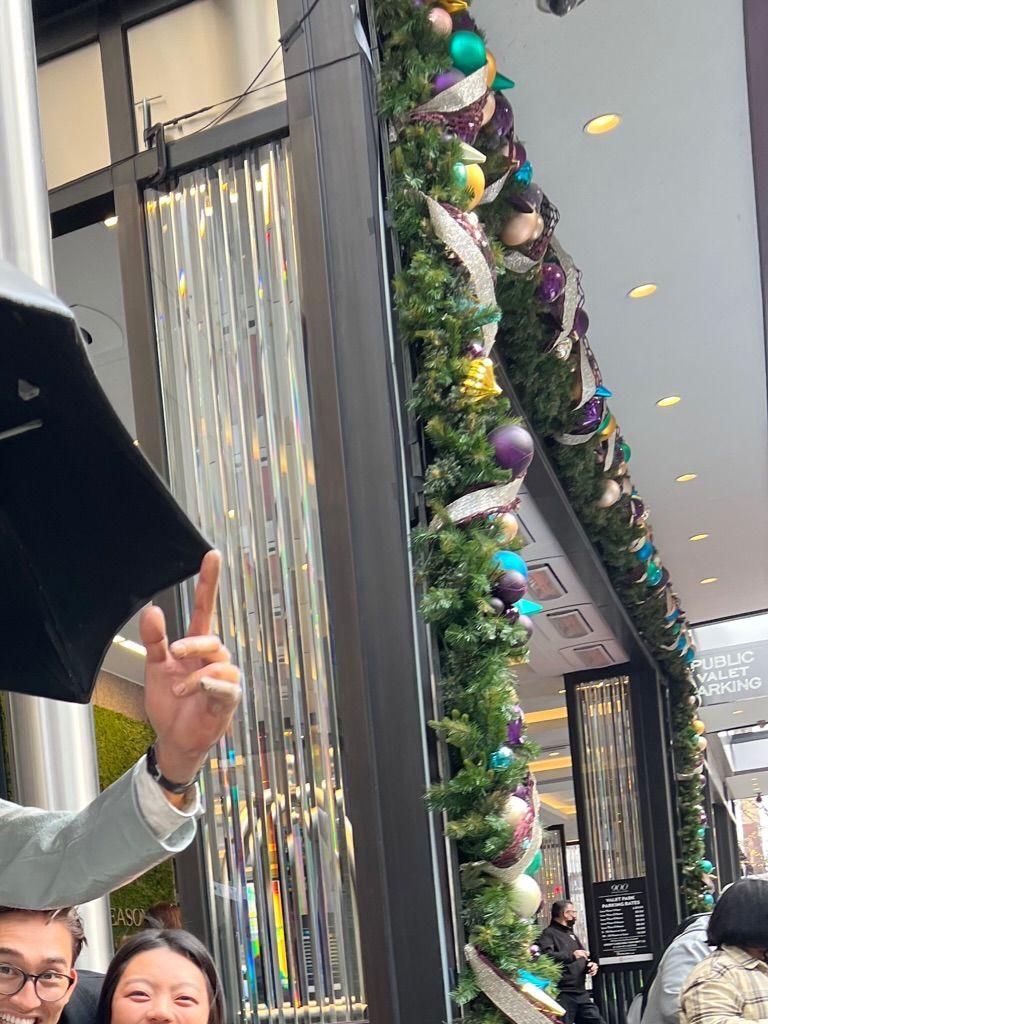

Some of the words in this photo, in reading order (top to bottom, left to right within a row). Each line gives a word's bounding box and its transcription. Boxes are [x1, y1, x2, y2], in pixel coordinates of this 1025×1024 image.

[690, 651, 754, 671] PUBLIC
[696, 666, 750, 683] VALET
[694, 677, 762, 697] ARKING
